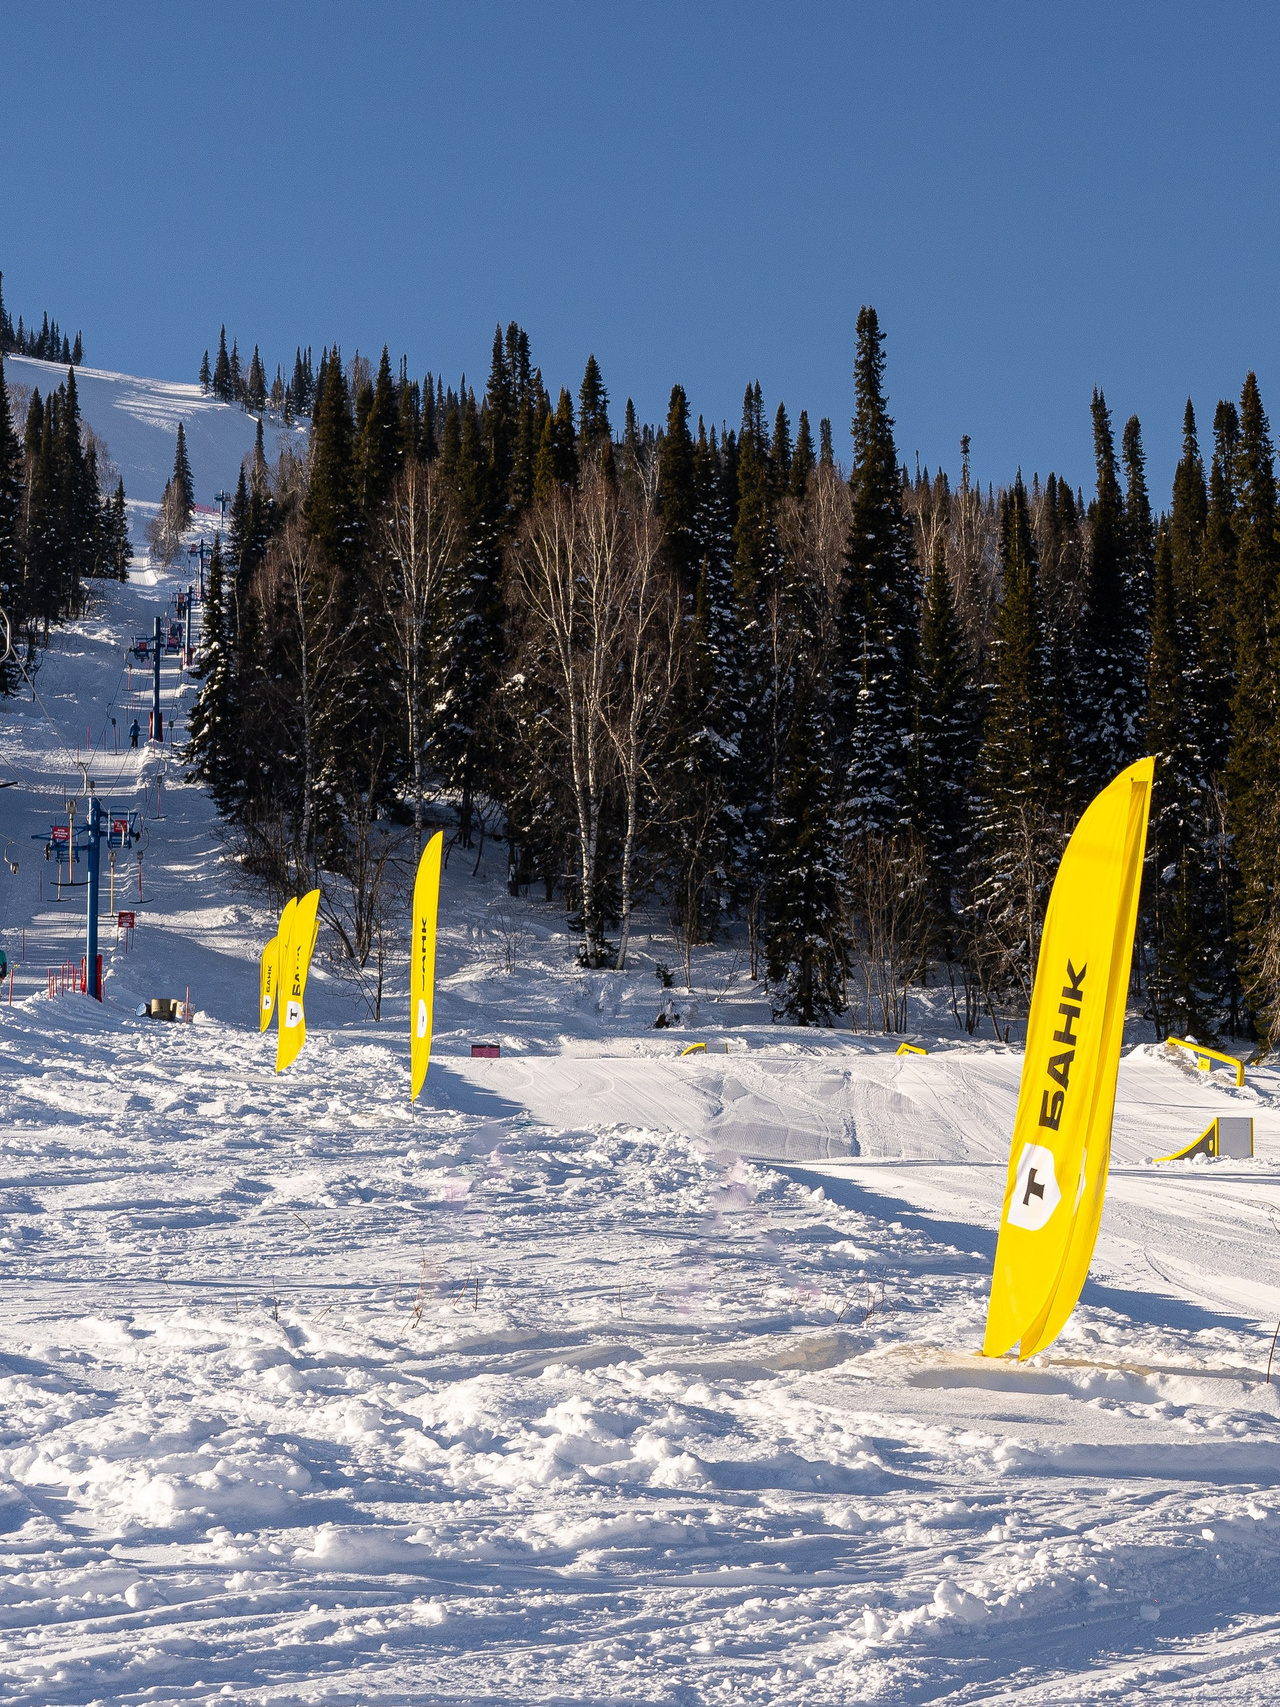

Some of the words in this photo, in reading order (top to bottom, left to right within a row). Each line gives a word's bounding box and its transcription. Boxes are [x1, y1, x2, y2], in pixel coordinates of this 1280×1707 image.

[289, 1008, 298, 1020] Т
[1022, 1167, 1045, 1206] Т
[1038, 958, 1088, 1131] БАНК
